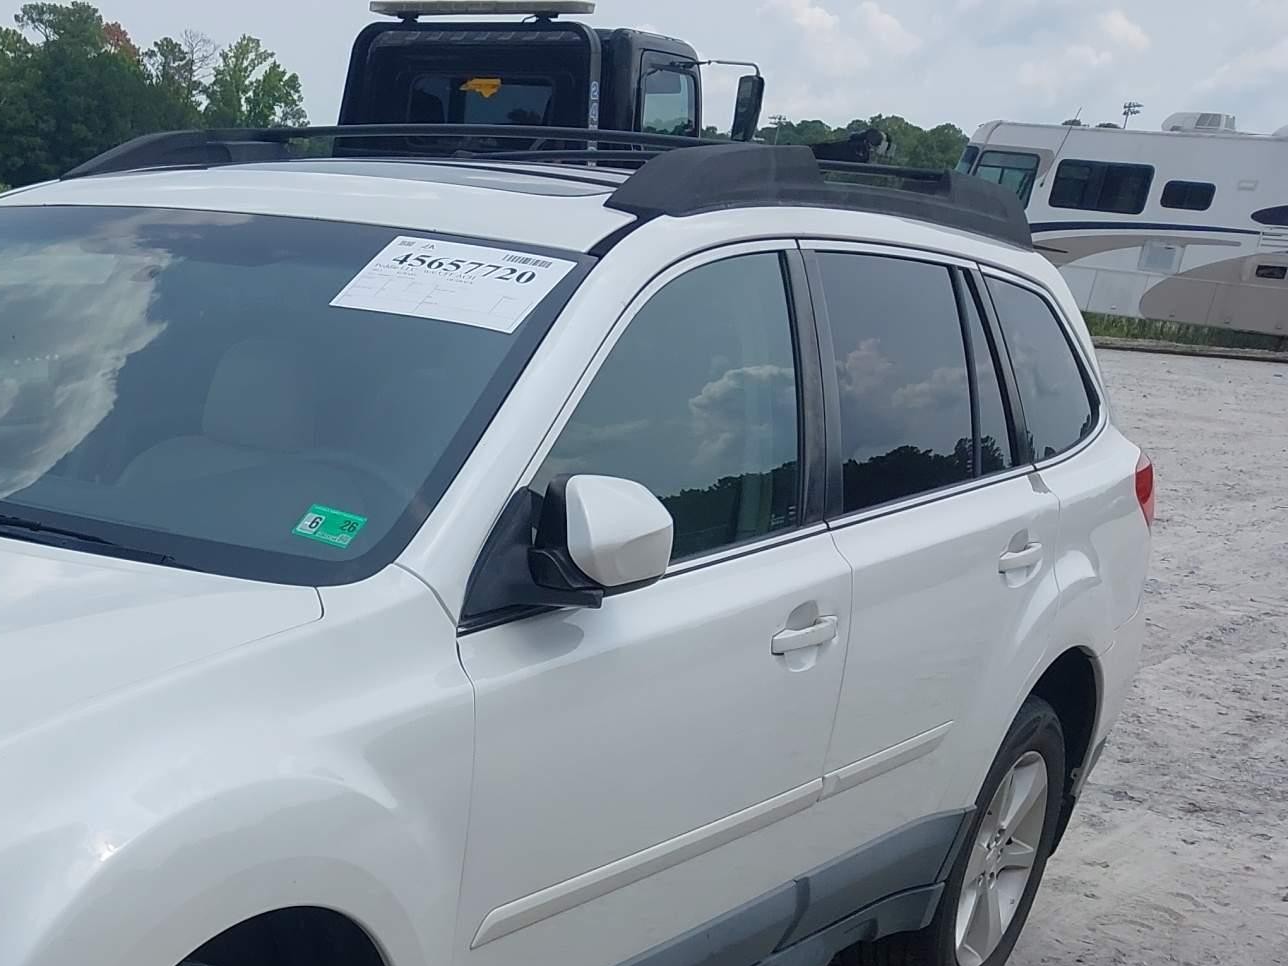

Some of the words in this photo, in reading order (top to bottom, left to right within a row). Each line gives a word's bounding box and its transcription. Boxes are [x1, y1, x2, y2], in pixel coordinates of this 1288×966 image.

[392, 252, 536, 285] 45657720
[308, 516, 322, 529] 6
[340, 519, 359, 533] 26
